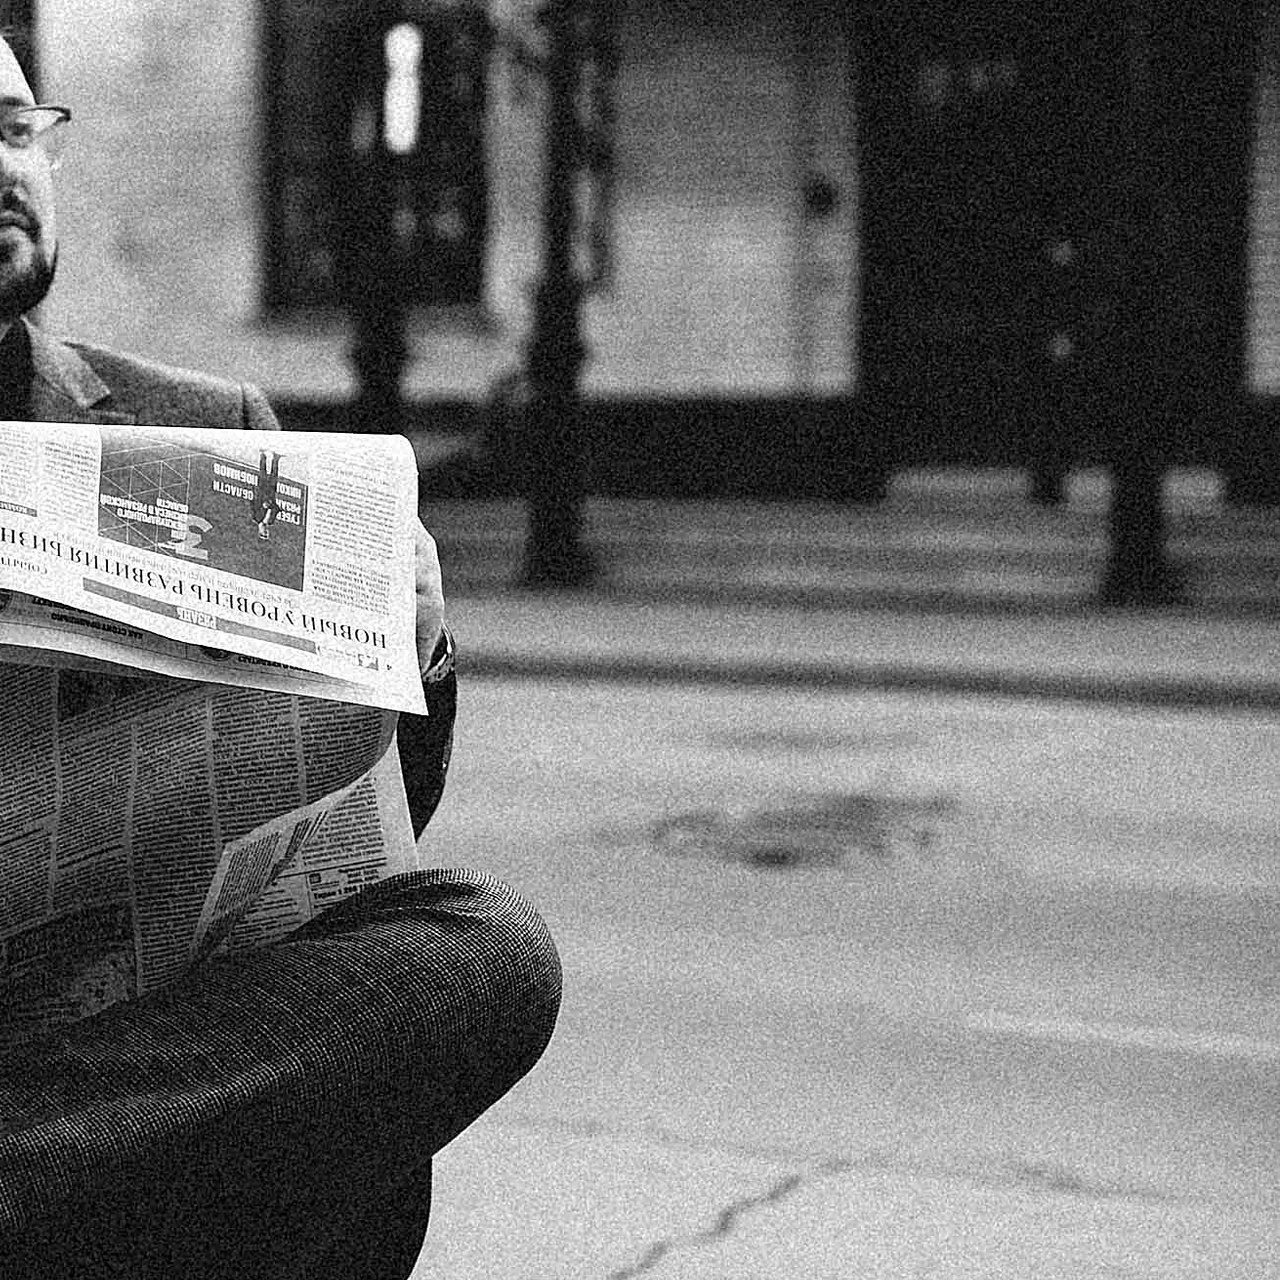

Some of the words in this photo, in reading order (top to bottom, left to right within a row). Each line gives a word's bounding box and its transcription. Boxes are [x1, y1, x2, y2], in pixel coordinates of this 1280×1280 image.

[213, 480, 254, 500] ОБЛАСТИ
[277, 482, 302, 499] НИКО
[100, 494, 147, 513] РЯЗАНСКОЙ
[275, 499, 301, 514] РЯЗАН
[276, 511, 300, 525] ГУБЕР
[69, 546, 183, 595] РАЗВИТИЯ
[190, 584, 295, 626] УРОВЕНЬ
[175, 607, 217, 629] РЯЗАНЬ
[300, 614, 386, 649] НОВЫЙ
